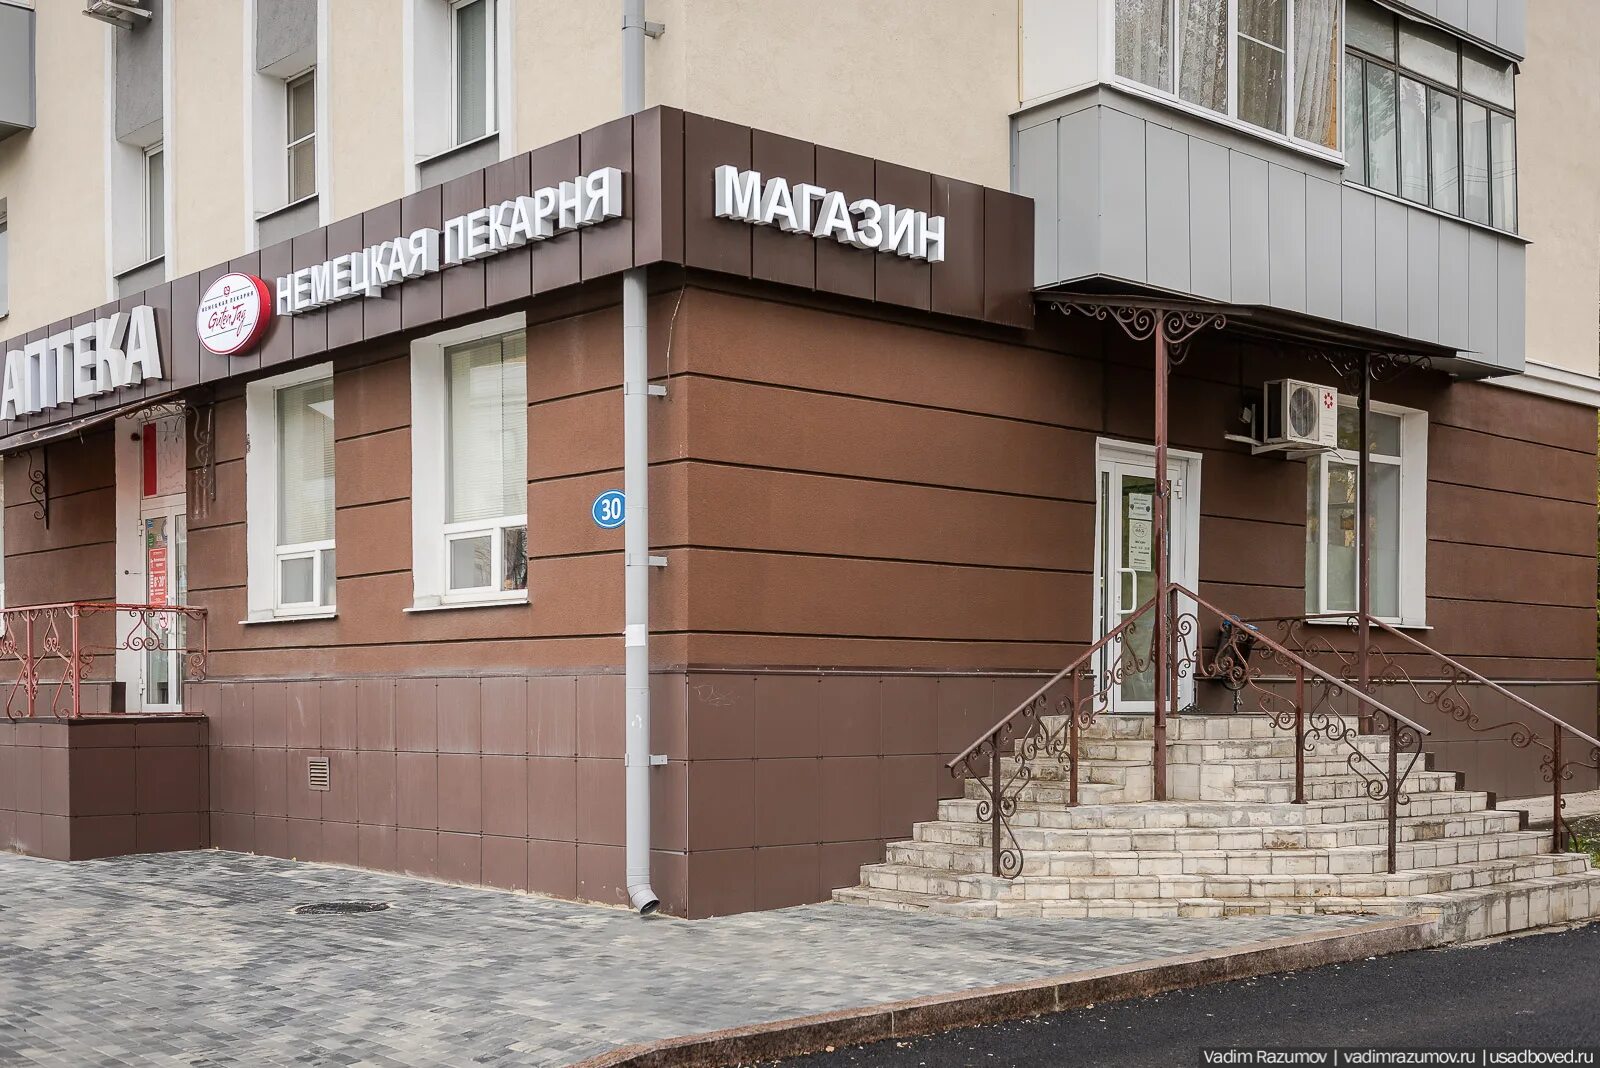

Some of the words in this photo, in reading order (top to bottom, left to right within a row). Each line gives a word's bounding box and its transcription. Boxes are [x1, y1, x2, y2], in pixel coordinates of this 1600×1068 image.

[276, 227, 440, 317] НЕМЕЦКАЯ
[444, 166, 622, 265] ПЕКАРНЯ
[714, 165, 945, 263] МАГАЗИН
[0, 304, 162, 421] АПТЕКА
[601, 497, 622, 521] 30
